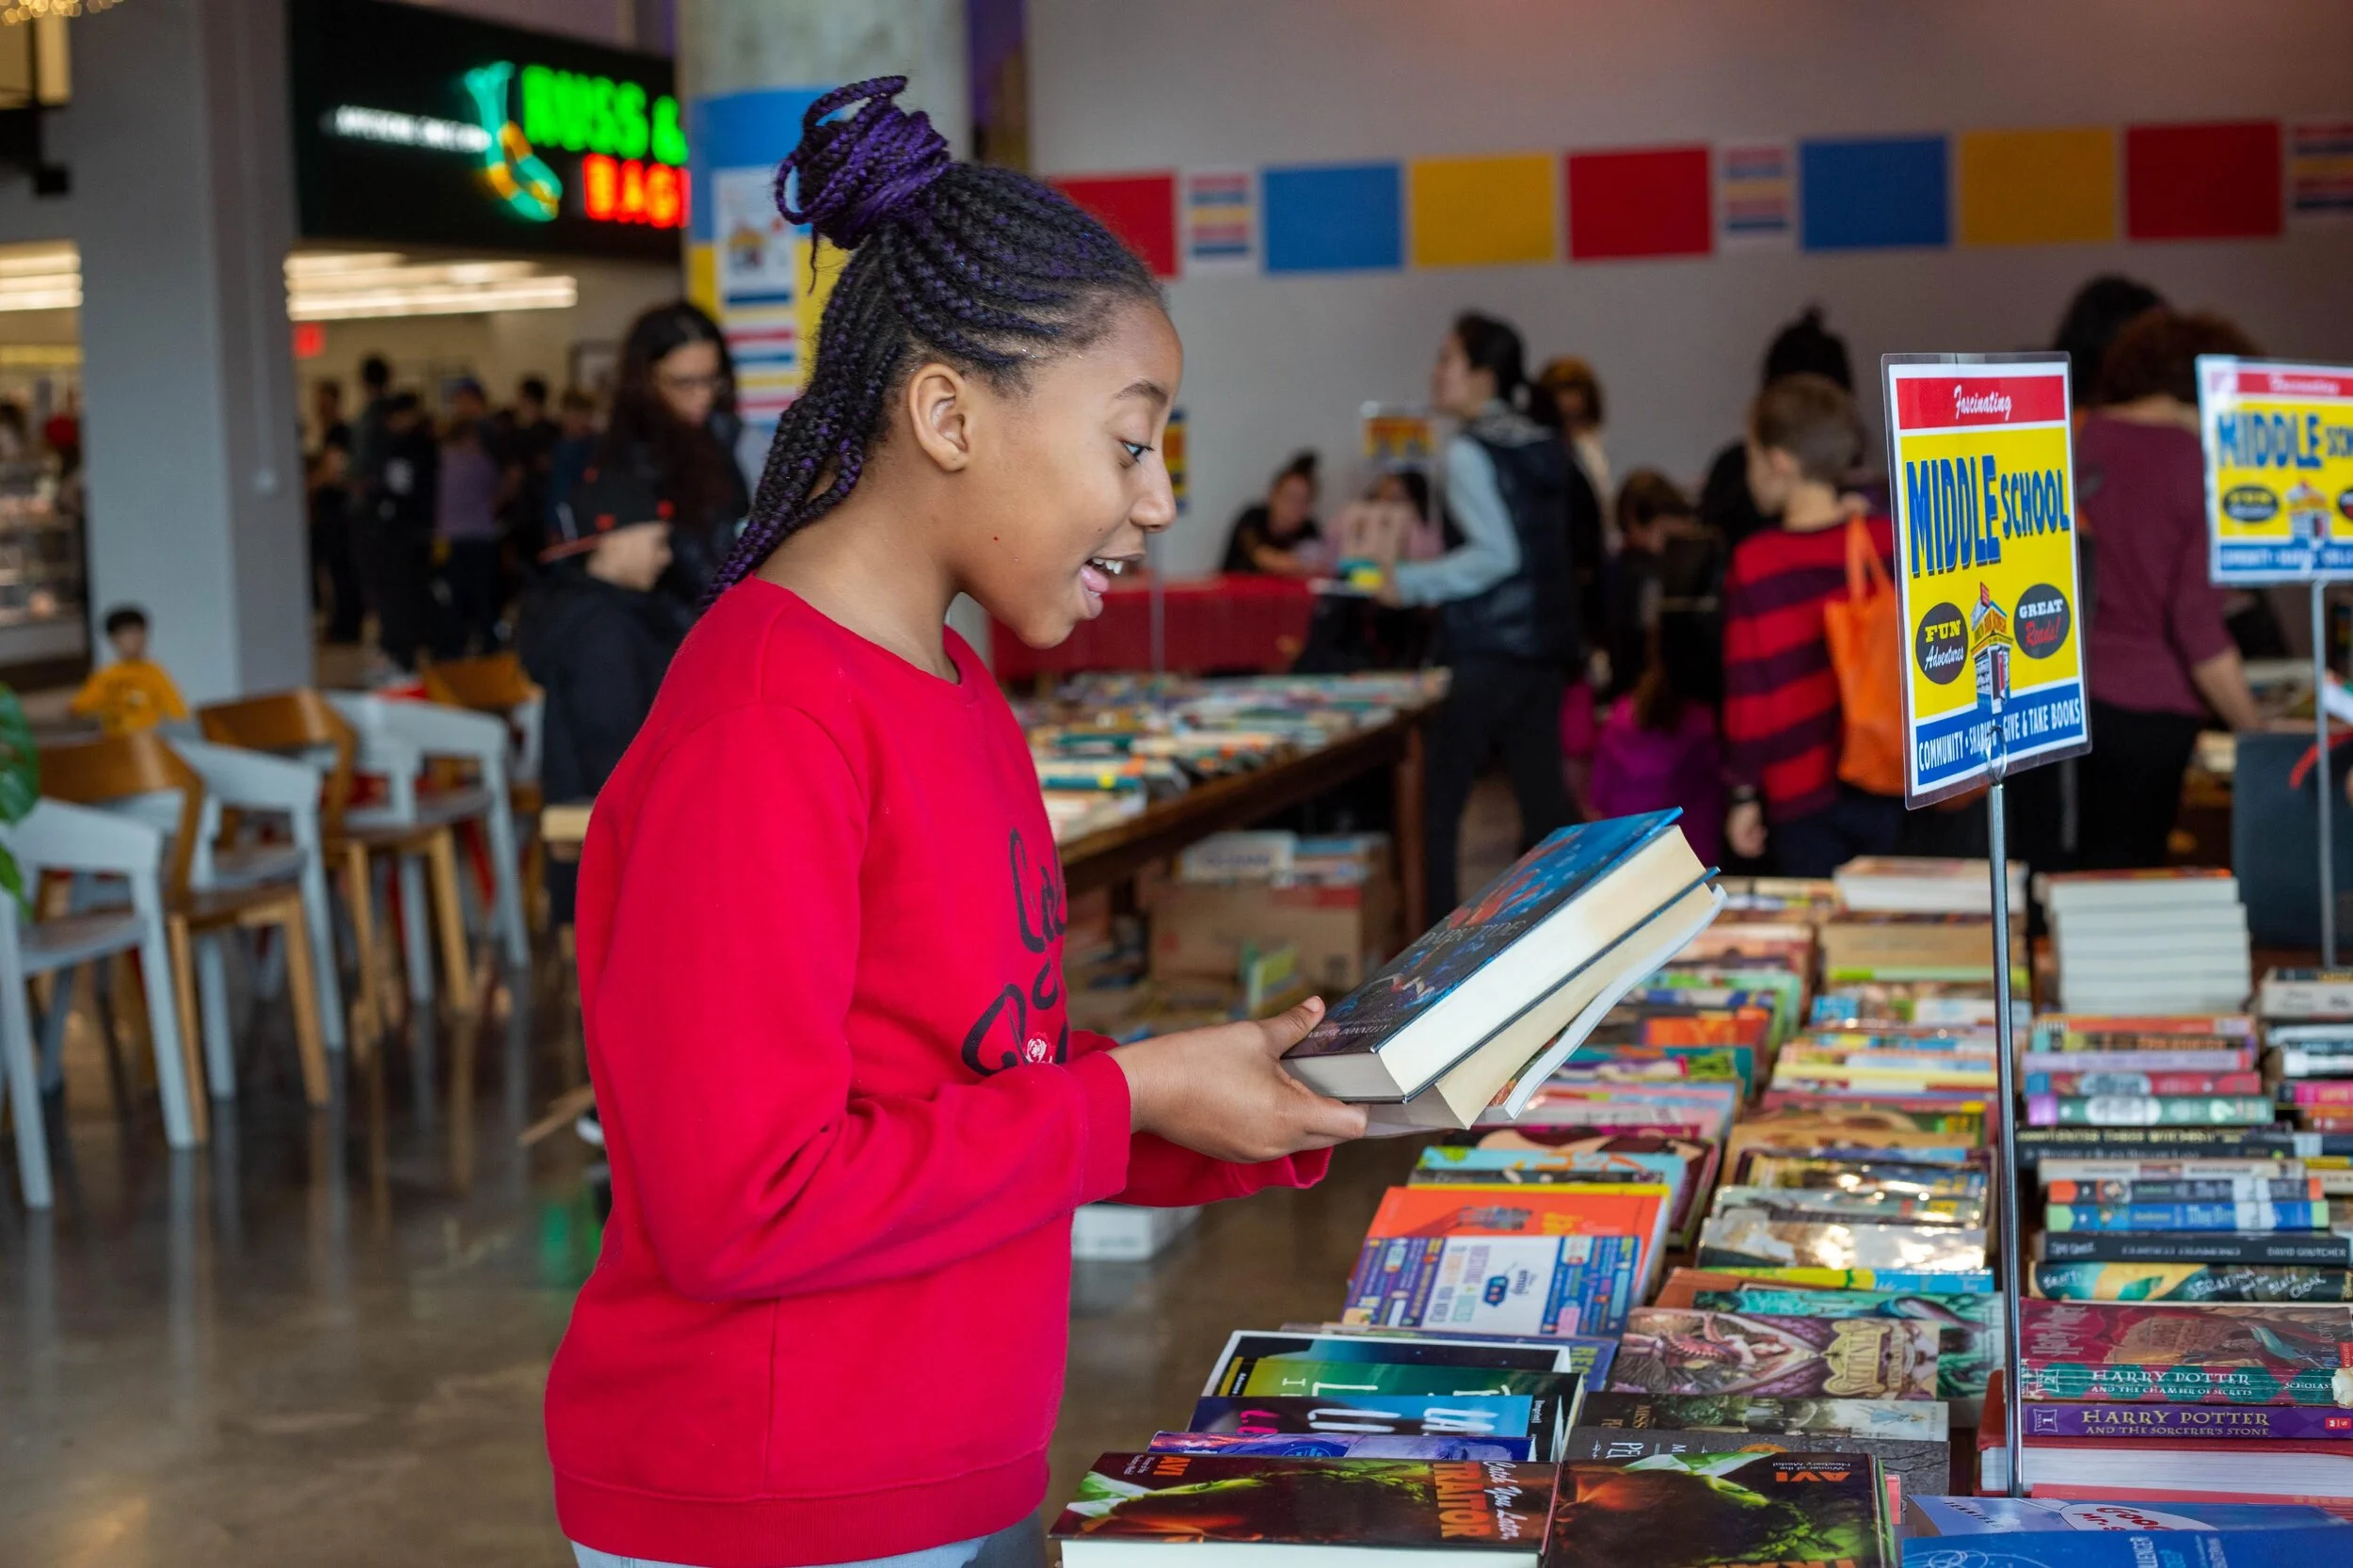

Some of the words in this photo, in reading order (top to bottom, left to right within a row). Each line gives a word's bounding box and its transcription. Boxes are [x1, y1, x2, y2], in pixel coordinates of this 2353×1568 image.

[1954, 384, 2012, 421] Fascinating
[2217, 412, 2323, 469] MIDDLE
[1906, 455, 2001, 579] MIDDLE
[2000, 469, 2070, 539] SCHOOL
[2019, 599, 2063, 619] GREAT
[1925, 619, 1961, 643] FUN
[2025, 617, 2060, 648] Reads!
[1925, 645, 1964, 671] Adventures
[1918, 729, 1963, 772] COMMUNITY
[2003, 714, 2019, 743] GIVE
[2022, 711, 2027, 736] &
[2028, 706, 2049, 735] TAKE
[2051, 697, 2081, 729] BOOKS
[2091, 1370, 2168, 1383] HARRY
[2176, 1372, 2250, 1385] POTTER
[2042, 1416, 2053, 1425] 1
[2081, 1410, 2170, 1424] HARRY
[2181, 1412, 2269, 1426] POTTER
[2148, 1427, 2224, 1435] SORCERER'S
[2227, 1428, 2269, 1436] STONE
[1153, 1455, 1191, 1476] AVI
[1776, 1471, 1851, 1482] AVI
[1433, 1462, 1492, 1538] TRAITOR
